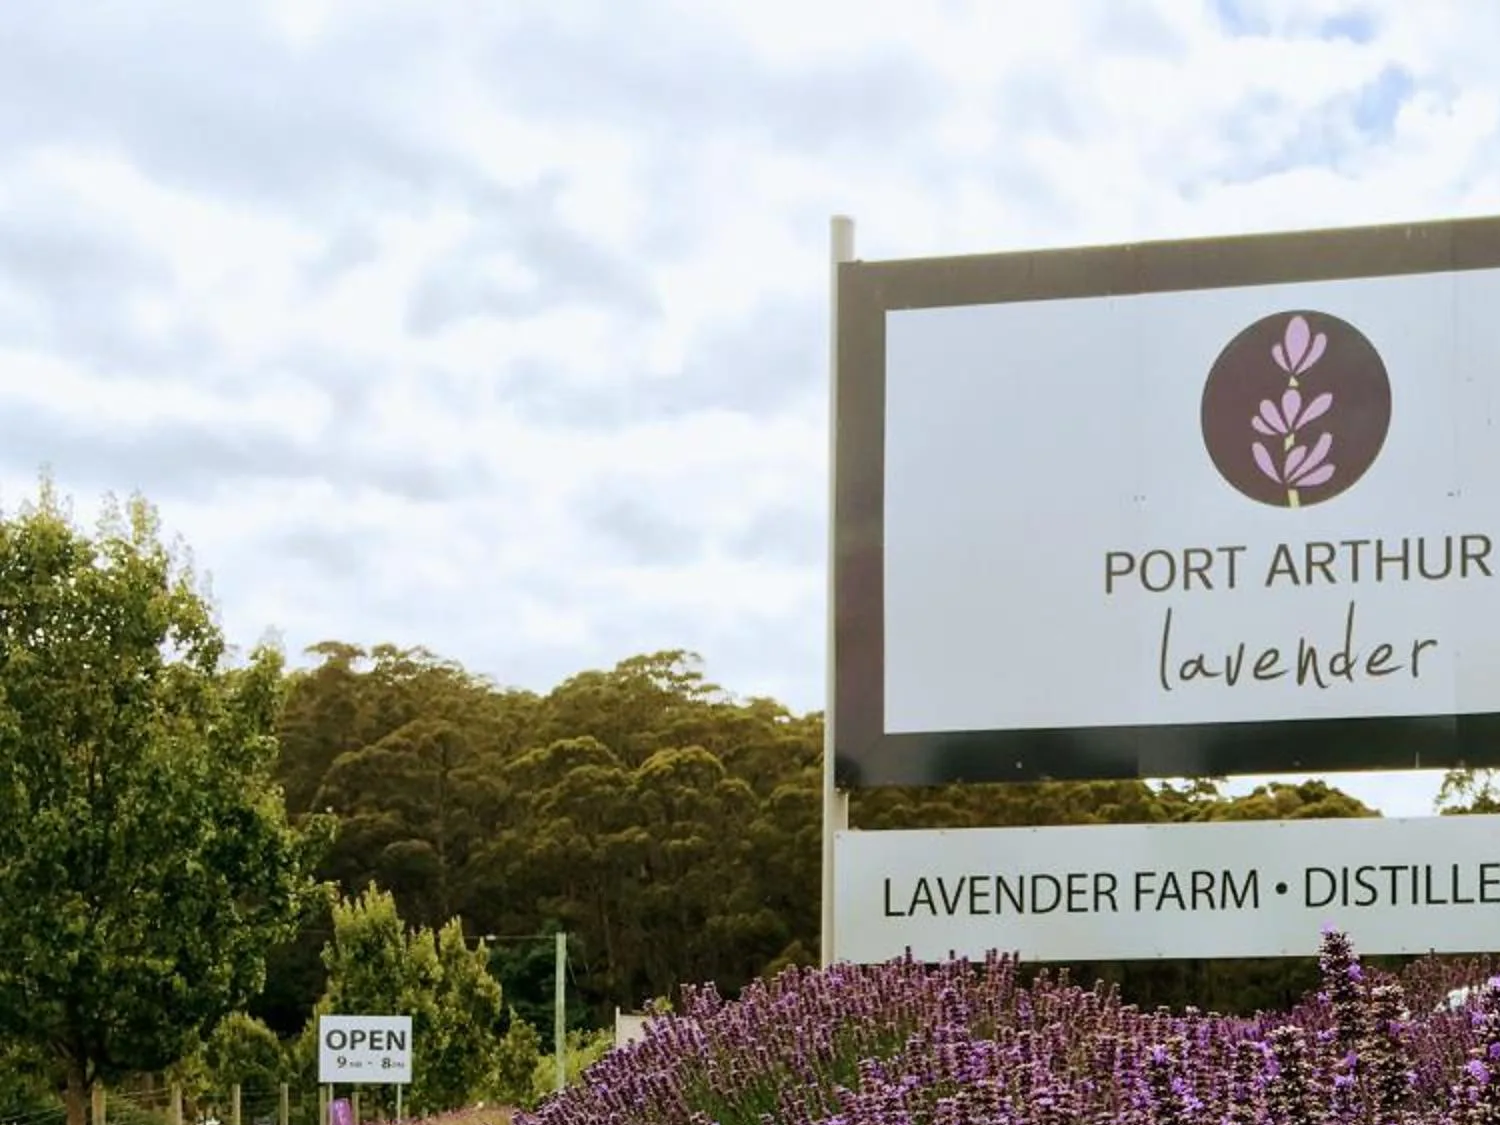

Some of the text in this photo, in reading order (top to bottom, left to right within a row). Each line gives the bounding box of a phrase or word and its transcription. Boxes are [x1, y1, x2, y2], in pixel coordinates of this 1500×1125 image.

[1104, 533, 1493, 595] PORT ARTHUR
[1158, 599, 1438, 691] lavender
[884, 872, 1119, 917] LAVENDER
[1133, 868, 1260, 912] FARM
[325, 1029, 406, 1051] OPEN
